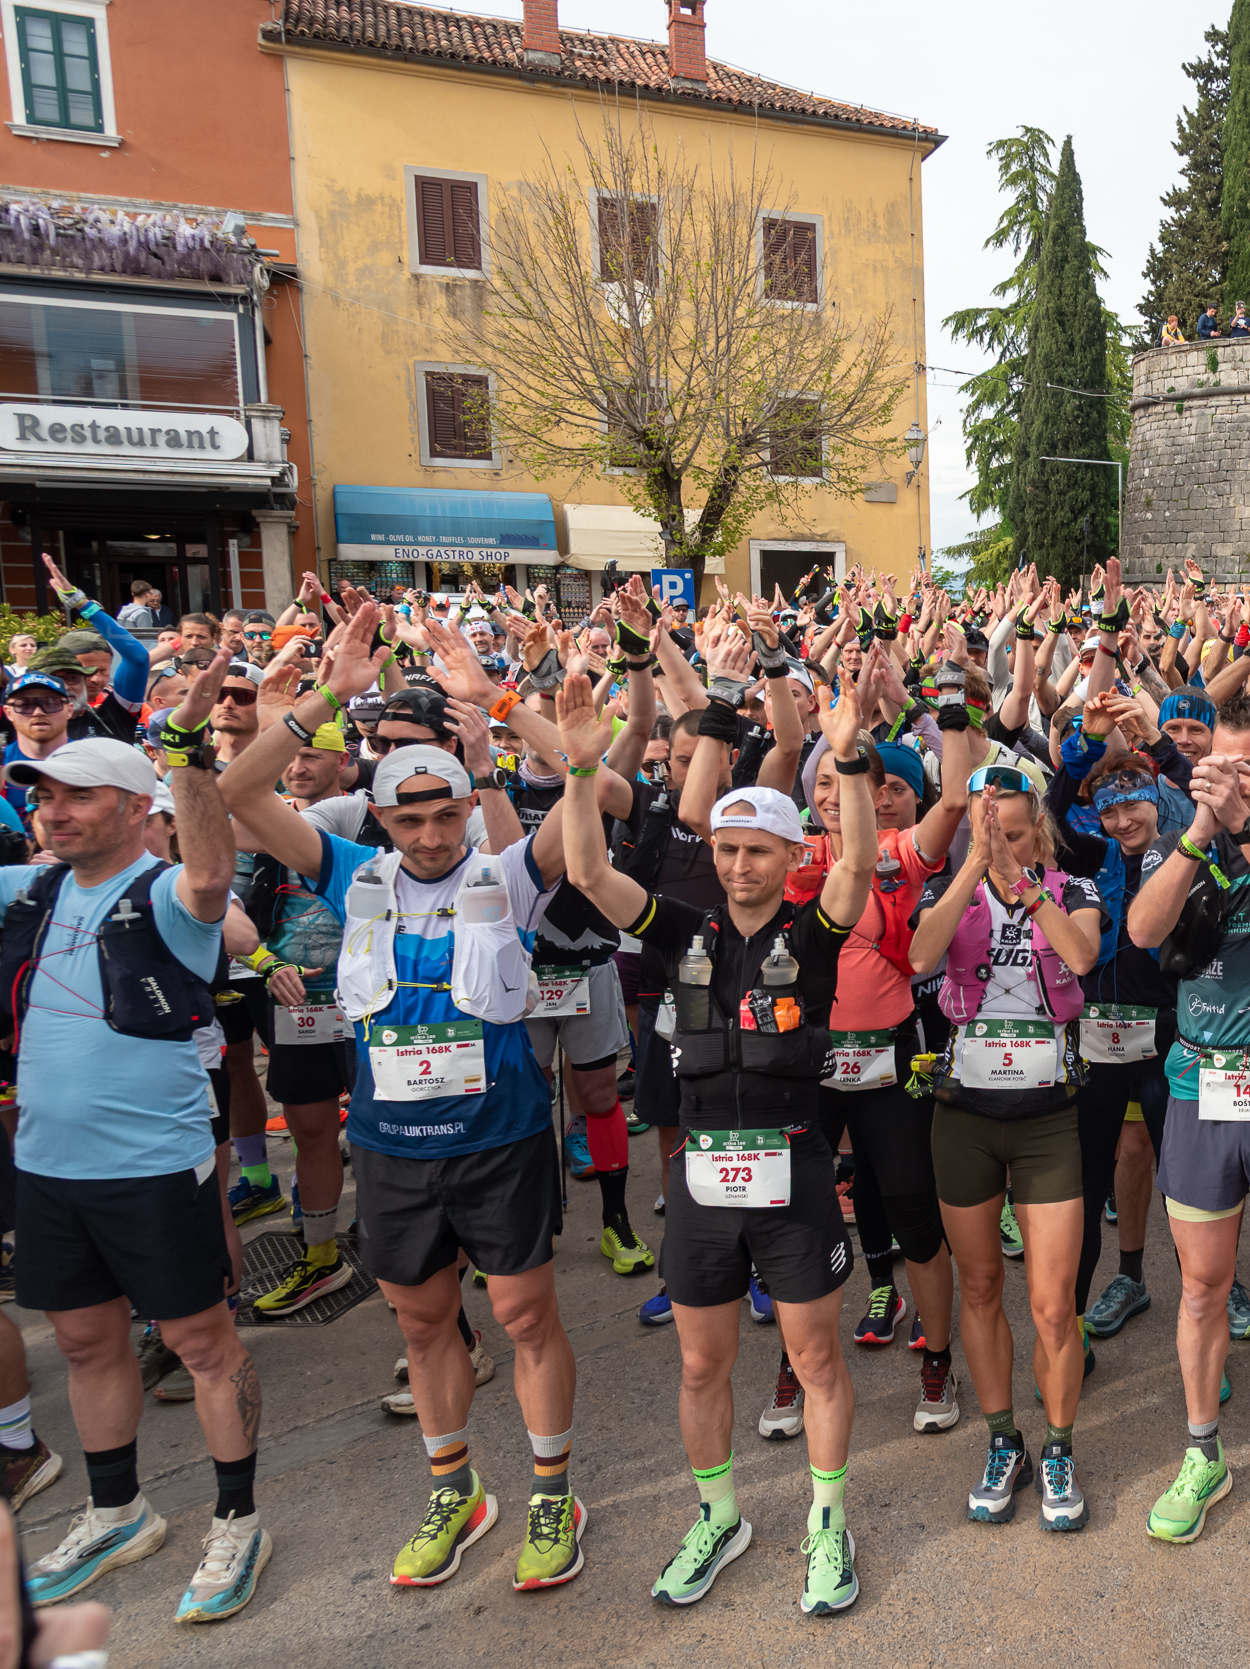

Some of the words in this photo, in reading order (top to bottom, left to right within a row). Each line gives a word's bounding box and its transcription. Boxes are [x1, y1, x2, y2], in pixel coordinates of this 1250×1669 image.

[12, 412, 221, 450] Restaurant
[405, 534, 415, 542] OIL
[418, 535, 436, 543] HONEY
[439, 536, 464, 544] TRUFFLES
[467, 536, 497, 545] SOUVENIRS
[394, 548, 474, 561] ENO-GASTRO
[479, 551, 511, 562] SHOP
[661, 574, 684, 597] P
[917, 976, 946, 998] NIK
[147, 976, 172, 1014] SALOMON
[1202, 1002, 1225, 1015] Fritid
[297, 1016, 315, 1028] 30
[1097, 1020, 1113, 1029] Istria
[985, 1039, 1006, 1048] Istria
[1009, 1039, 1032, 1049] 168K
[1111, 1032, 1120, 1044] 8
[396, 1048, 422, 1057] Istria
[426, 1045, 452, 1055] 168K
[852, 1049, 872, 1058] 168K
[1002, 1053, 1013, 1067] 5
[418, 1060, 432, 1076] 2
[840, 1061, 861, 1075] 26
[407, 1077, 446, 1087] BARTOSZ
[1224, 1073, 1247, 1081] Istria
[711, 1153, 734, 1162] Istria
[736, 1152, 761, 1162] 168K
[719, 1167, 753, 1183] 273
